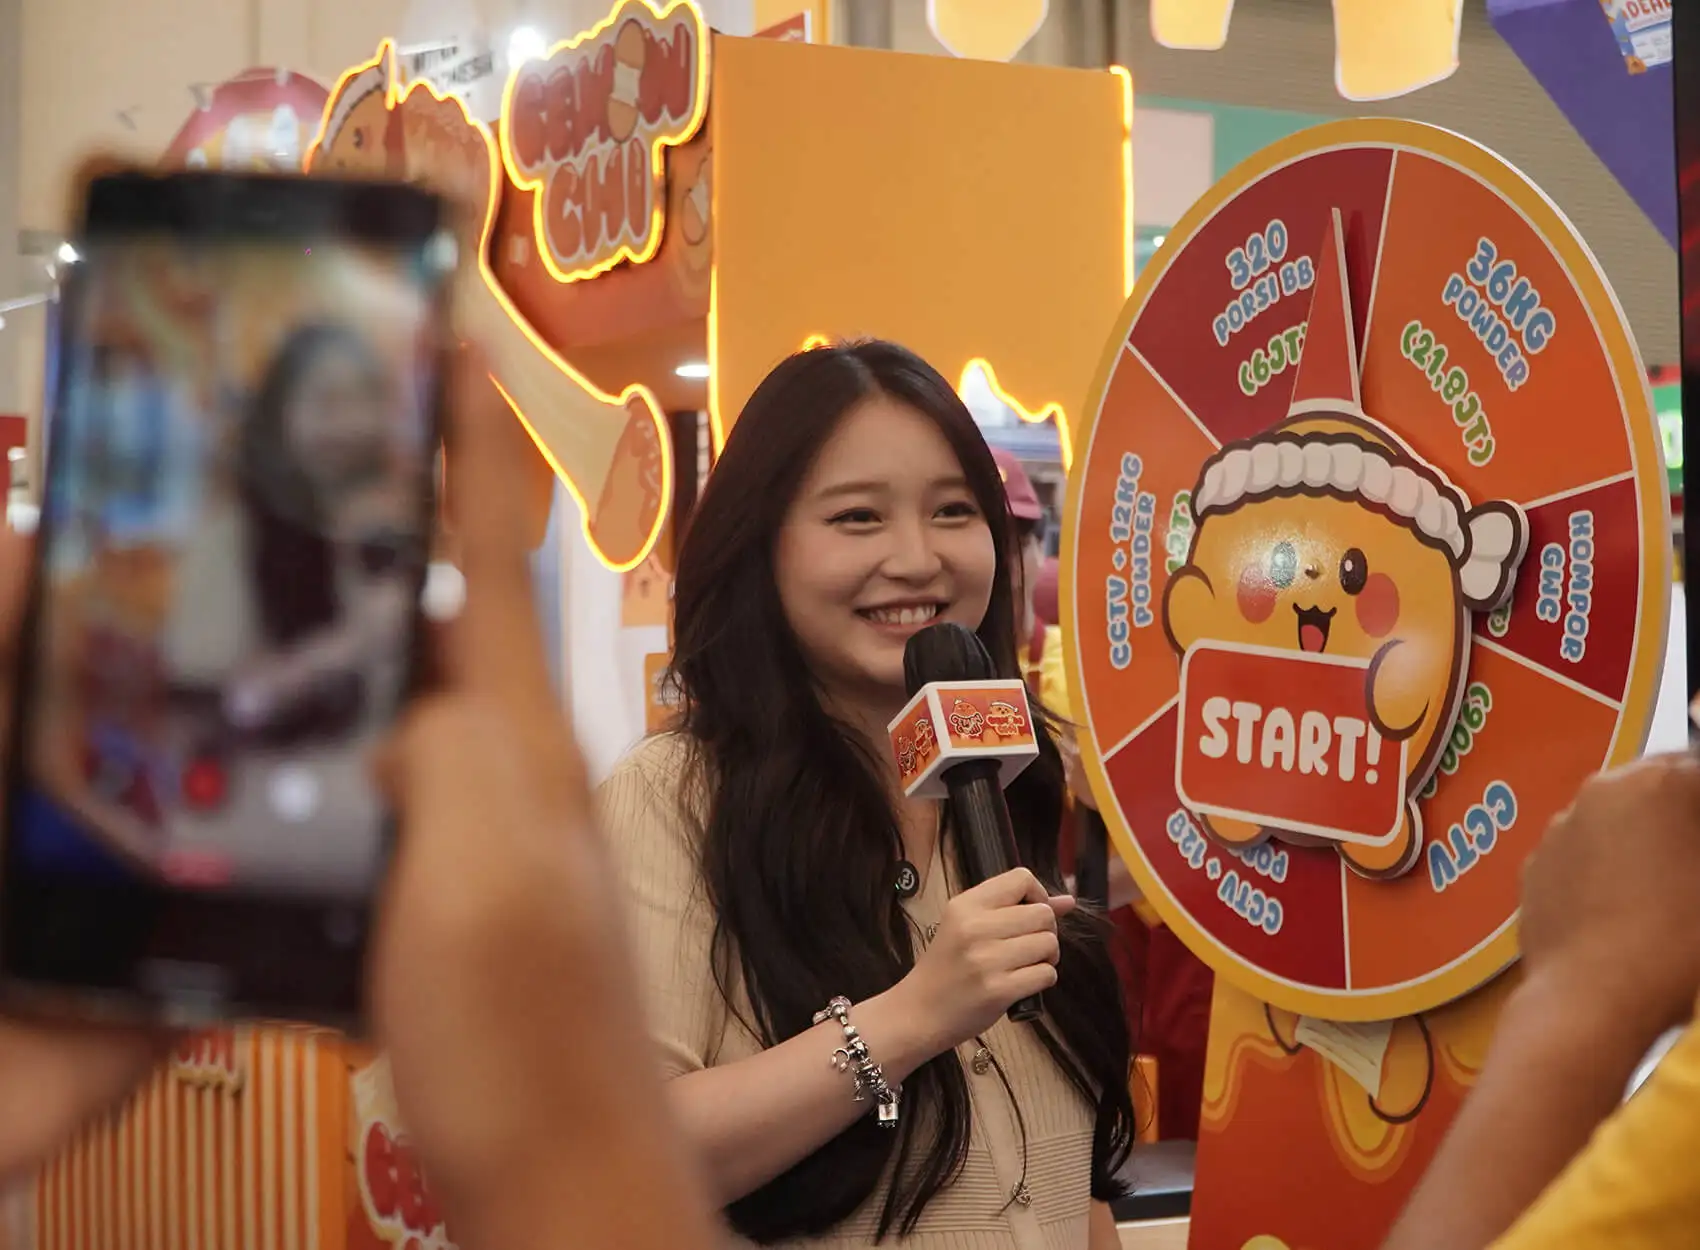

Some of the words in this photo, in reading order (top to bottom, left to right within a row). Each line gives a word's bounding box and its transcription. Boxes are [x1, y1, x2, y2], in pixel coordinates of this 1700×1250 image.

[1213, 272, 1280, 346] PORSI
[1280, 256, 1315, 296] BB
[1226, 219, 1288, 290] 320
[1467, 237, 1555, 354] 36KG
[1442, 273, 1529, 392] POWDER
[1401, 321, 1495, 466] (21,8JT)
[1110, 452, 1143, 544] 12KG
[1112, 548, 1127, 571] +
[1131, 491, 1156, 628] POWDER
[1536, 542, 1565, 623] GWC
[1560, 510, 1594, 663] KOMPOR
[1107, 574, 1132, 669] CCTV
[1200, 696, 1382, 785] START!
[1427, 780, 1518, 893] CCTV
[1217, 870, 1283, 935] CCTV
